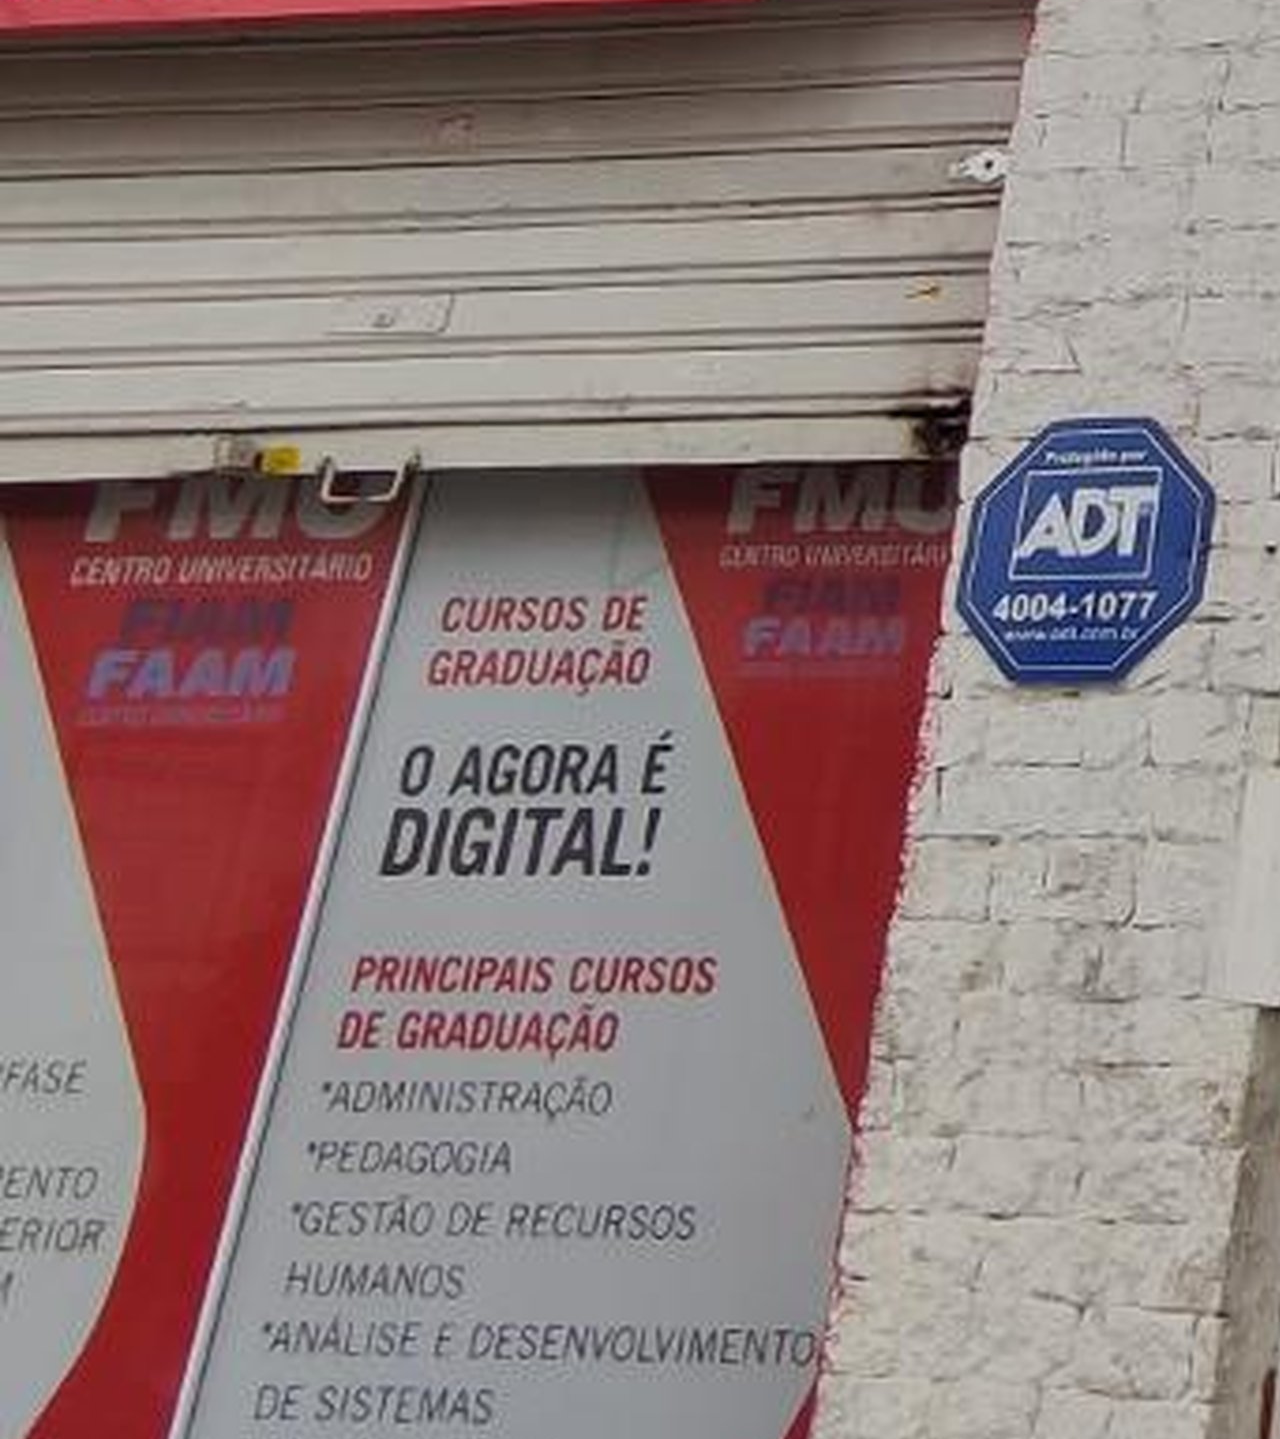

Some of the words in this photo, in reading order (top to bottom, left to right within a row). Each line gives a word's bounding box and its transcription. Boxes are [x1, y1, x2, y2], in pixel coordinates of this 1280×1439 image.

[1017, 485, 1160, 559] ADT
[69, 555, 171, 587] CENTRO
[177, 549, 374, 583] UNIVERSITÁRIO
[441, 596, 587, 633] CURSOS
[602, 595, 648, 631] DE
[992, 589, 1158, 622] 4004-1077
[86, 647, 297, 699] FAAM
[427, 639, 651, 696] GRADUAÇÃO
[400, 745, 436, 797] O
[448, 743, 618, 797] AGORA
[642, 730, 674, 794] É
[379, 807, 662, 877] DIGITAL!
[352, 955, 554, 993] PRINCIPAIS
[569, 957, 718, 994] CURSOS
[338, 1010, 385, 1049] DE
[396, 1004, 622, 1061] GRADUAÇÃO
[0, 1058, 88, 1095] FASE
[0, 1165, 98, 1201] ENTO
[446, 1202, 495, 1236] DE
[505, 1203, 697, 1242] RECURSOS
[284, 1261, 467, 1300] HUMANOS
[432, 1324, 454, 1359] E
[467, 1322, 815, 1368] DESENVOLVIMENTO
[253, 1384, 302, 1422] DE
[314, 1385, 495, 1425] SISTEMAS
